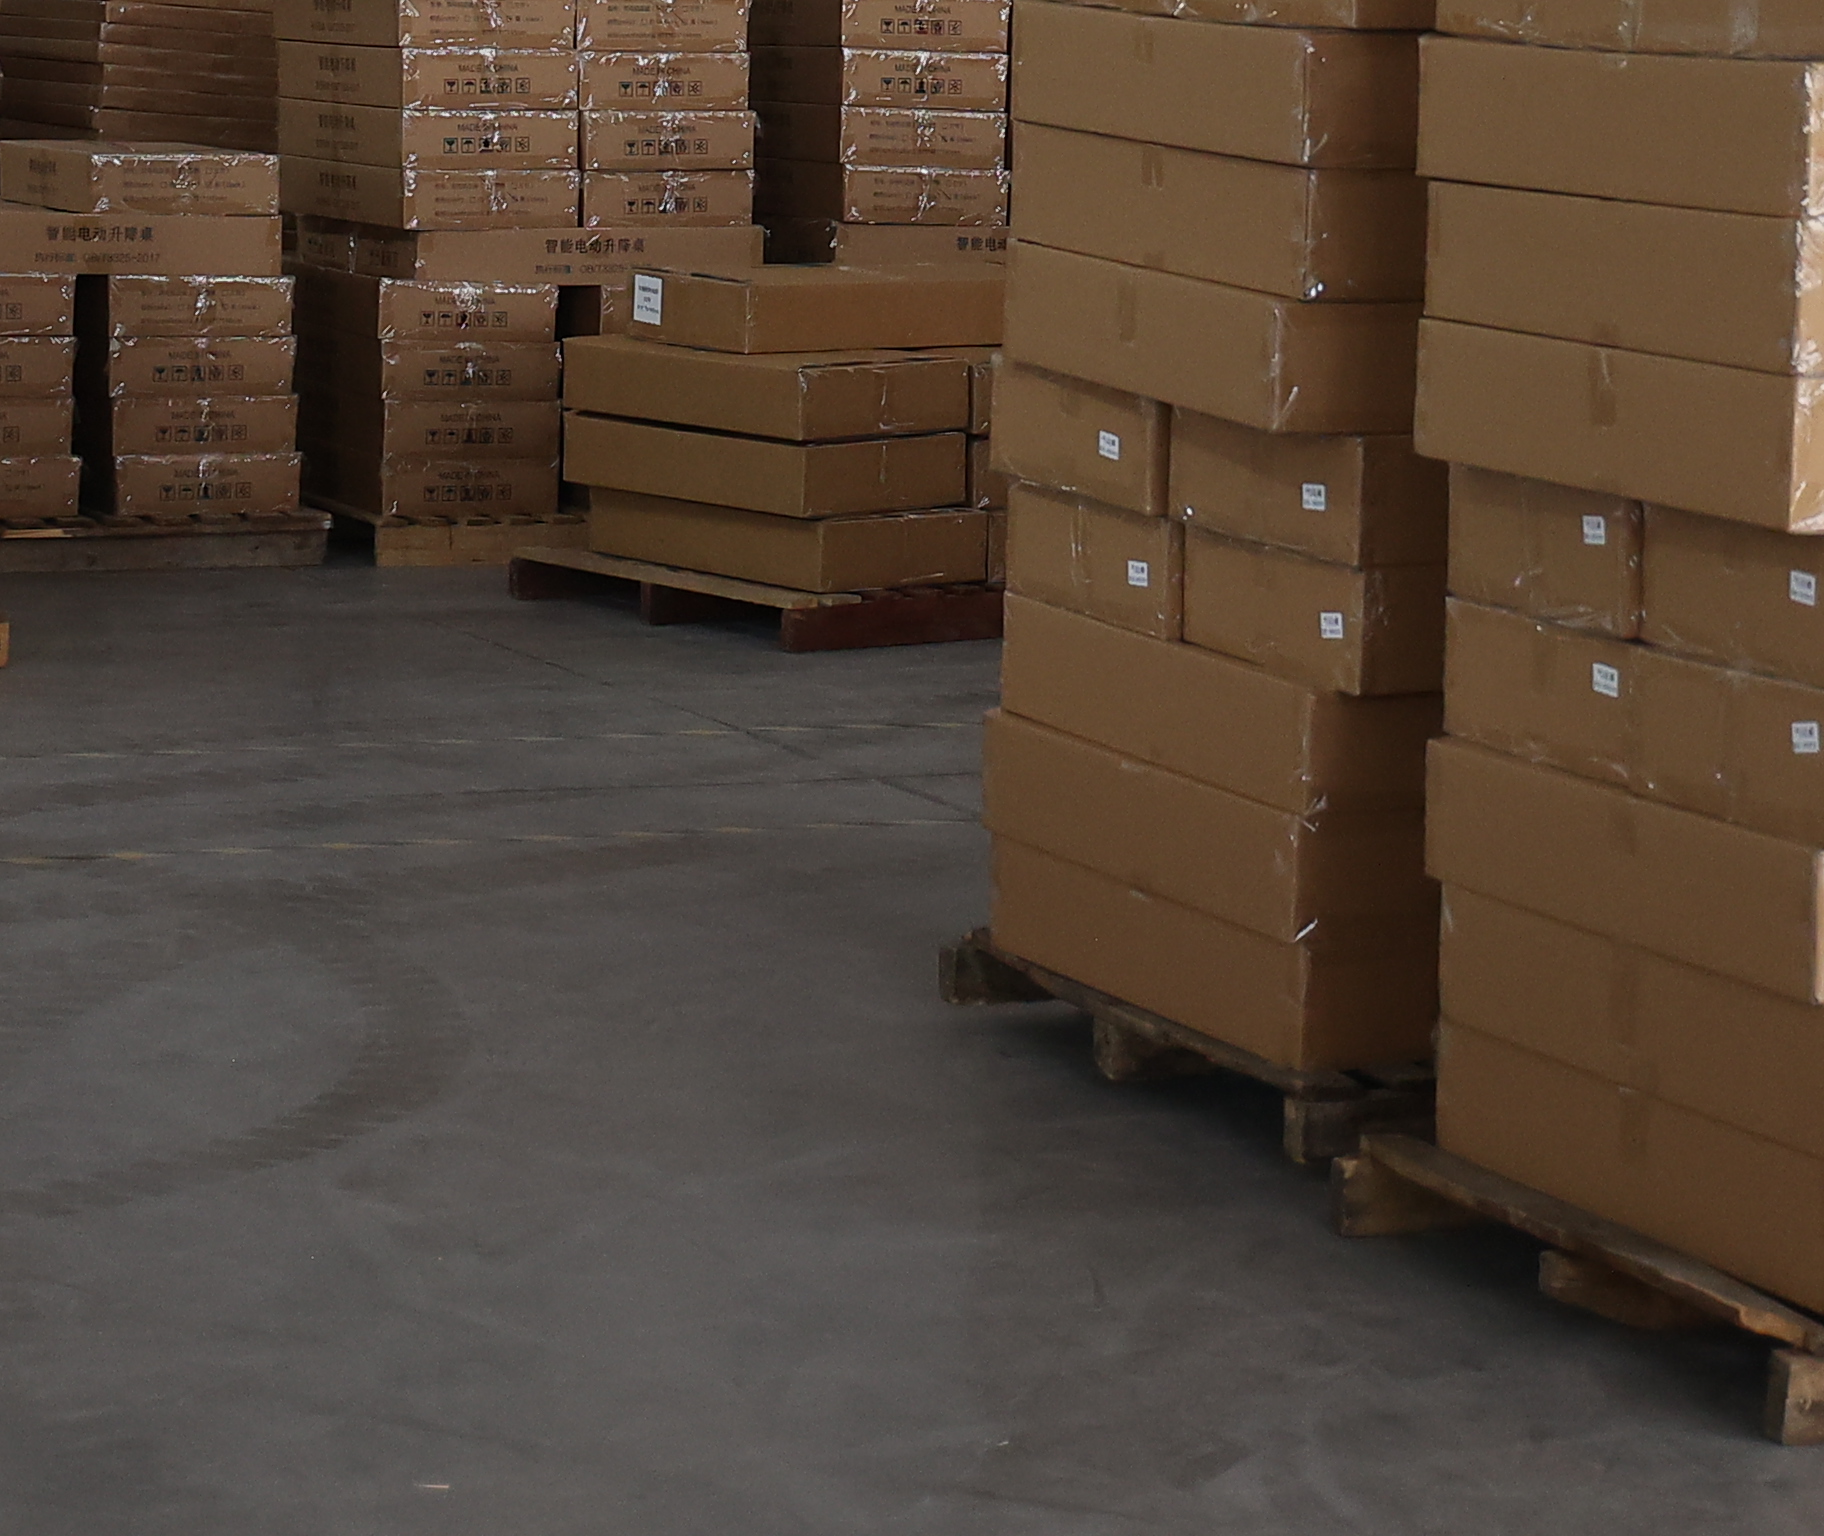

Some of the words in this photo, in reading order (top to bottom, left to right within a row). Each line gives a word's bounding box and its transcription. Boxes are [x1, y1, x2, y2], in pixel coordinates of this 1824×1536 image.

[46, 226, 155, 243] 智能电动升降桌
[544, 237, 646, 255] 智能电动升降桌
